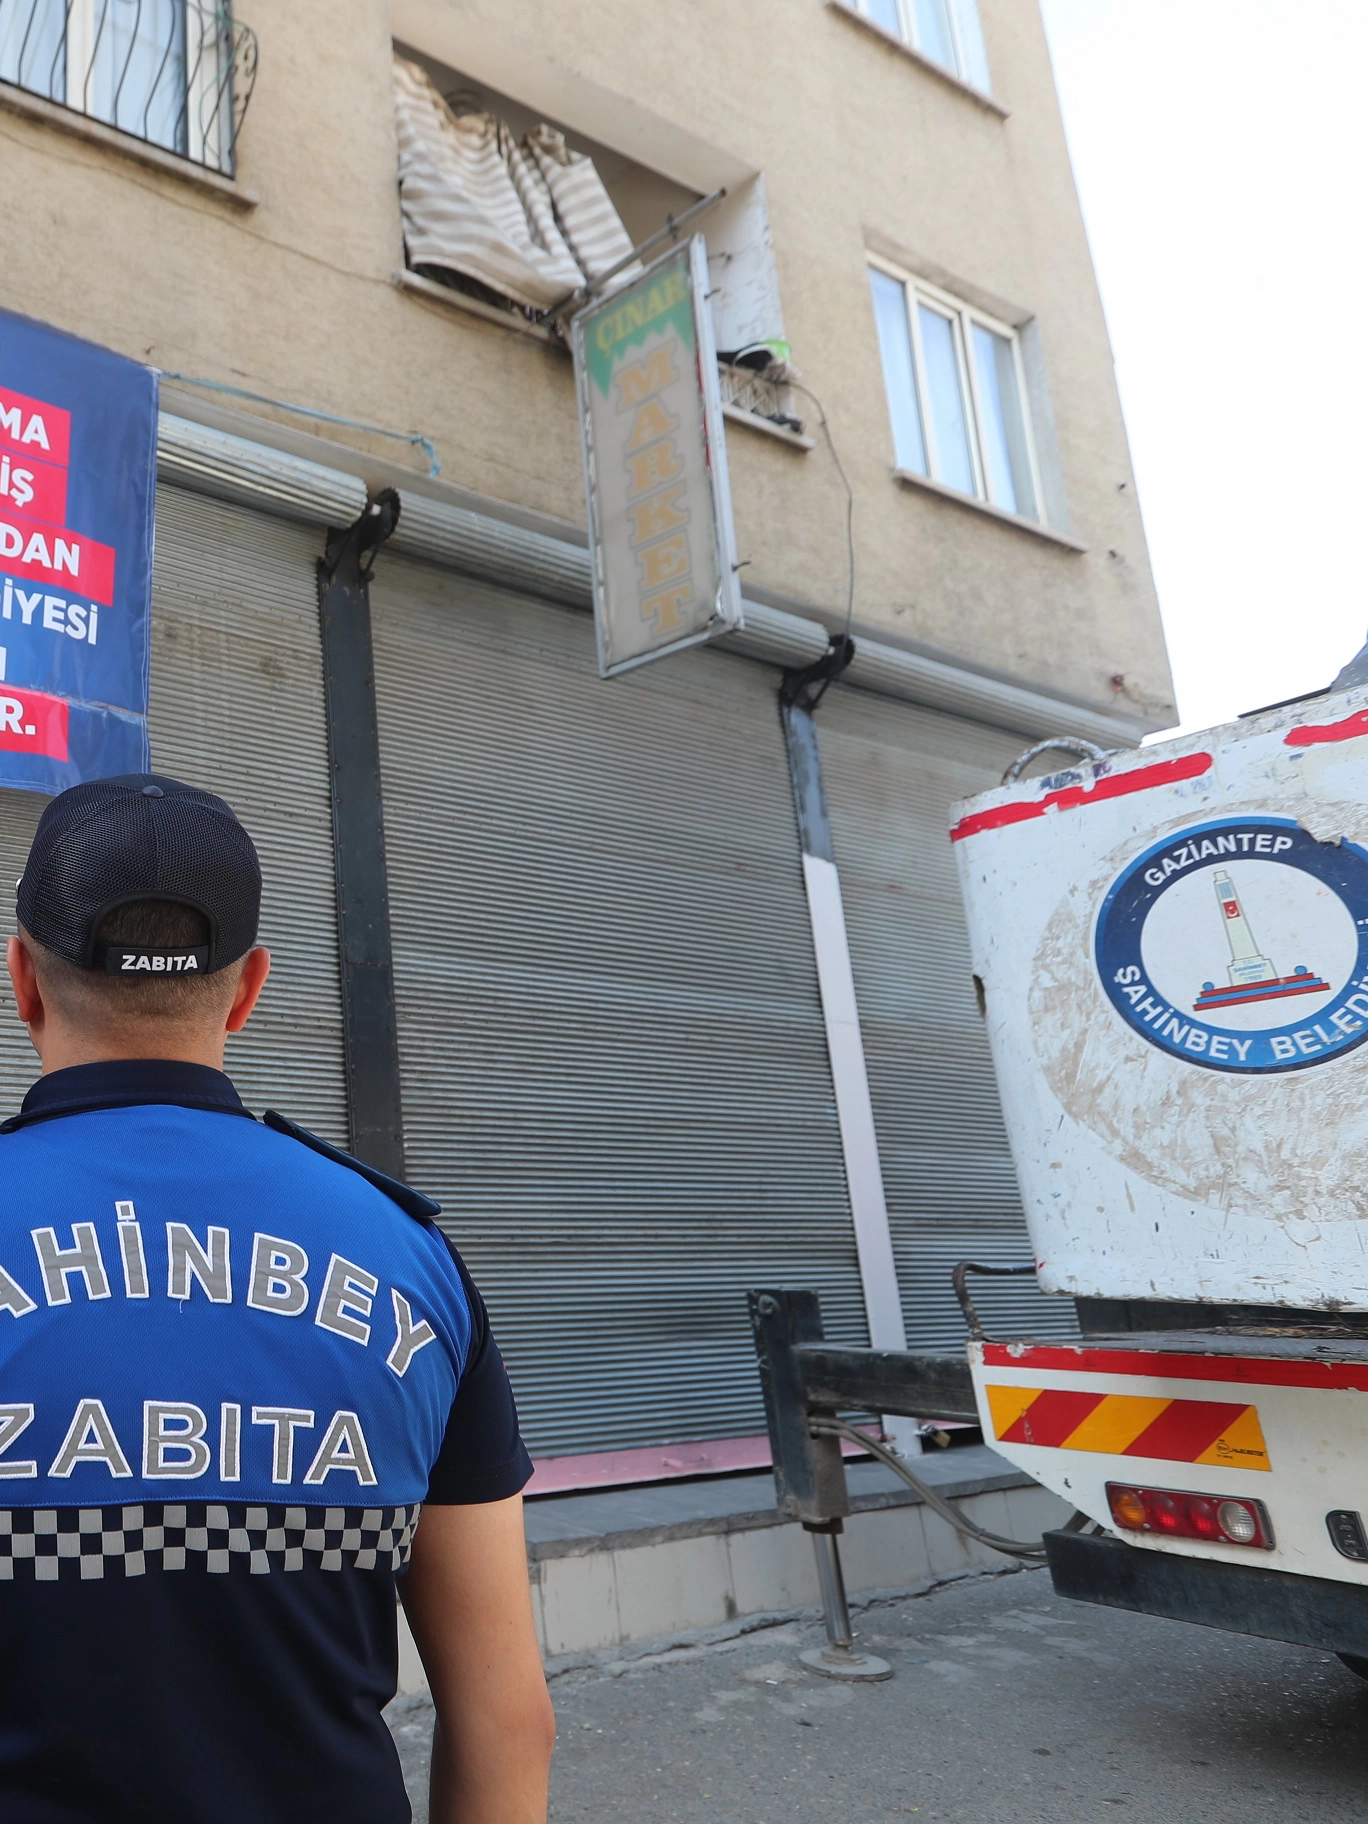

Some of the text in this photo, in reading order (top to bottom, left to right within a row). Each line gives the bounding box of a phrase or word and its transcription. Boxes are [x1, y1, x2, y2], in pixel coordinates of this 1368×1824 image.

[614, 338, 695, 639] MARKET
[1143, 832, 1294, 887] GAZİANTEP
[121, 954, 198, 972] ZABITA
[1113, 964, 1368, 1062] ŞAHİNBEY BELEDİ
